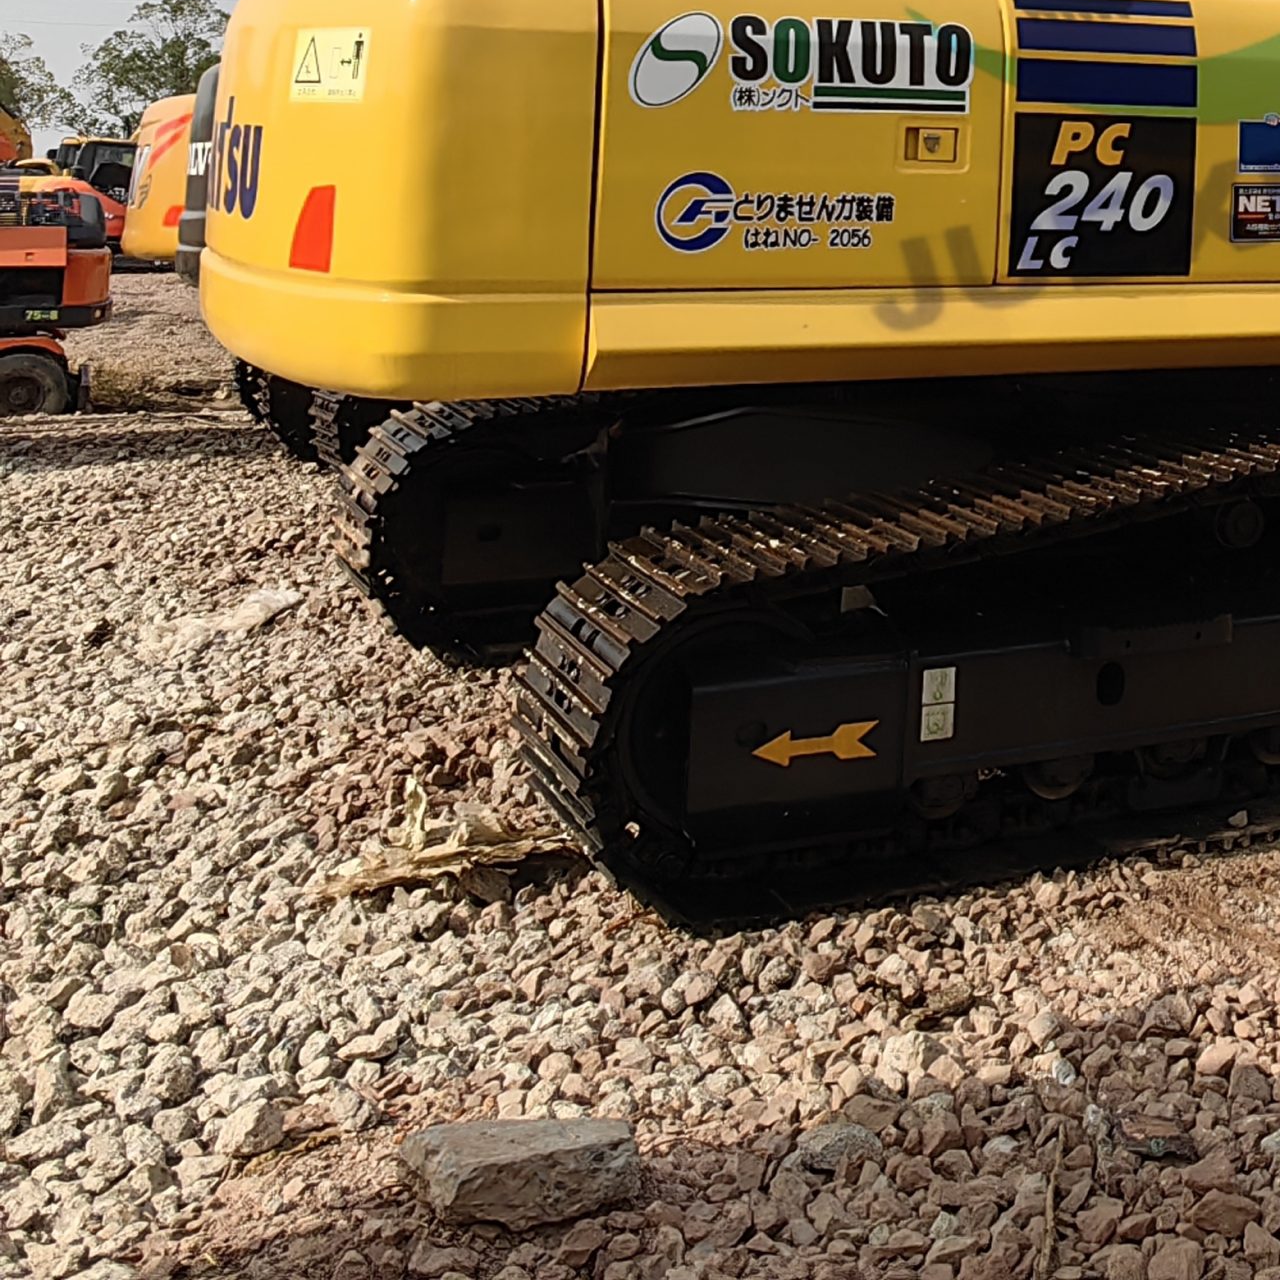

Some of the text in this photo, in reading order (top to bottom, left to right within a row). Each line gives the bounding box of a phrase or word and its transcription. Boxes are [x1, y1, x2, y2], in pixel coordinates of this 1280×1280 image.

[730, 15, 972, 86] SOKUTO
[1050, 120, 1132, 166] PC
[1029, 170, 1175, 232] 240
[829, 228, 872, 248] 2056
[1016, 235, 1079, 270] LC
